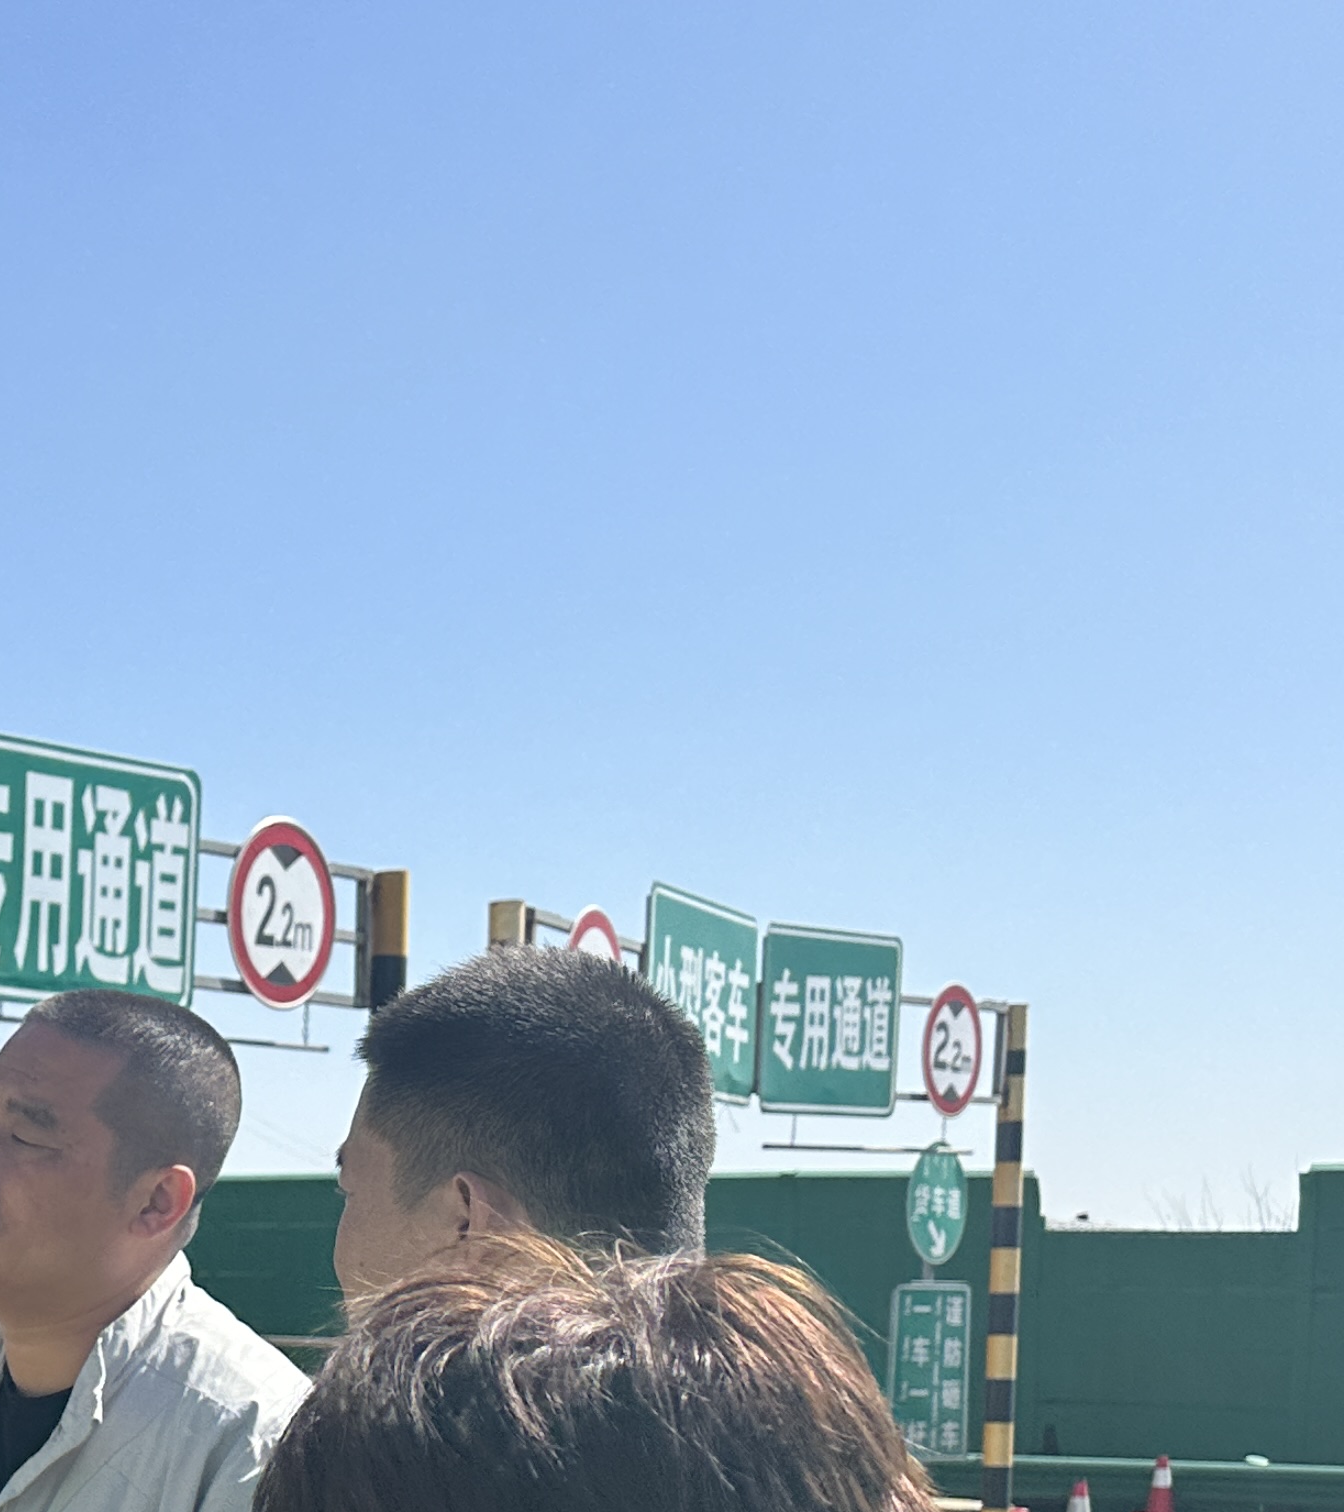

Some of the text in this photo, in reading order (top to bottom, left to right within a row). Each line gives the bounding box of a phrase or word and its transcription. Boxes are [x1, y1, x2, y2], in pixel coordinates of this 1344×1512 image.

[256, 876, 313, 955] 2.2m
[656, 935, 750, 1063] 小型客车
[770, 968, 892, 1071] 专用通道
